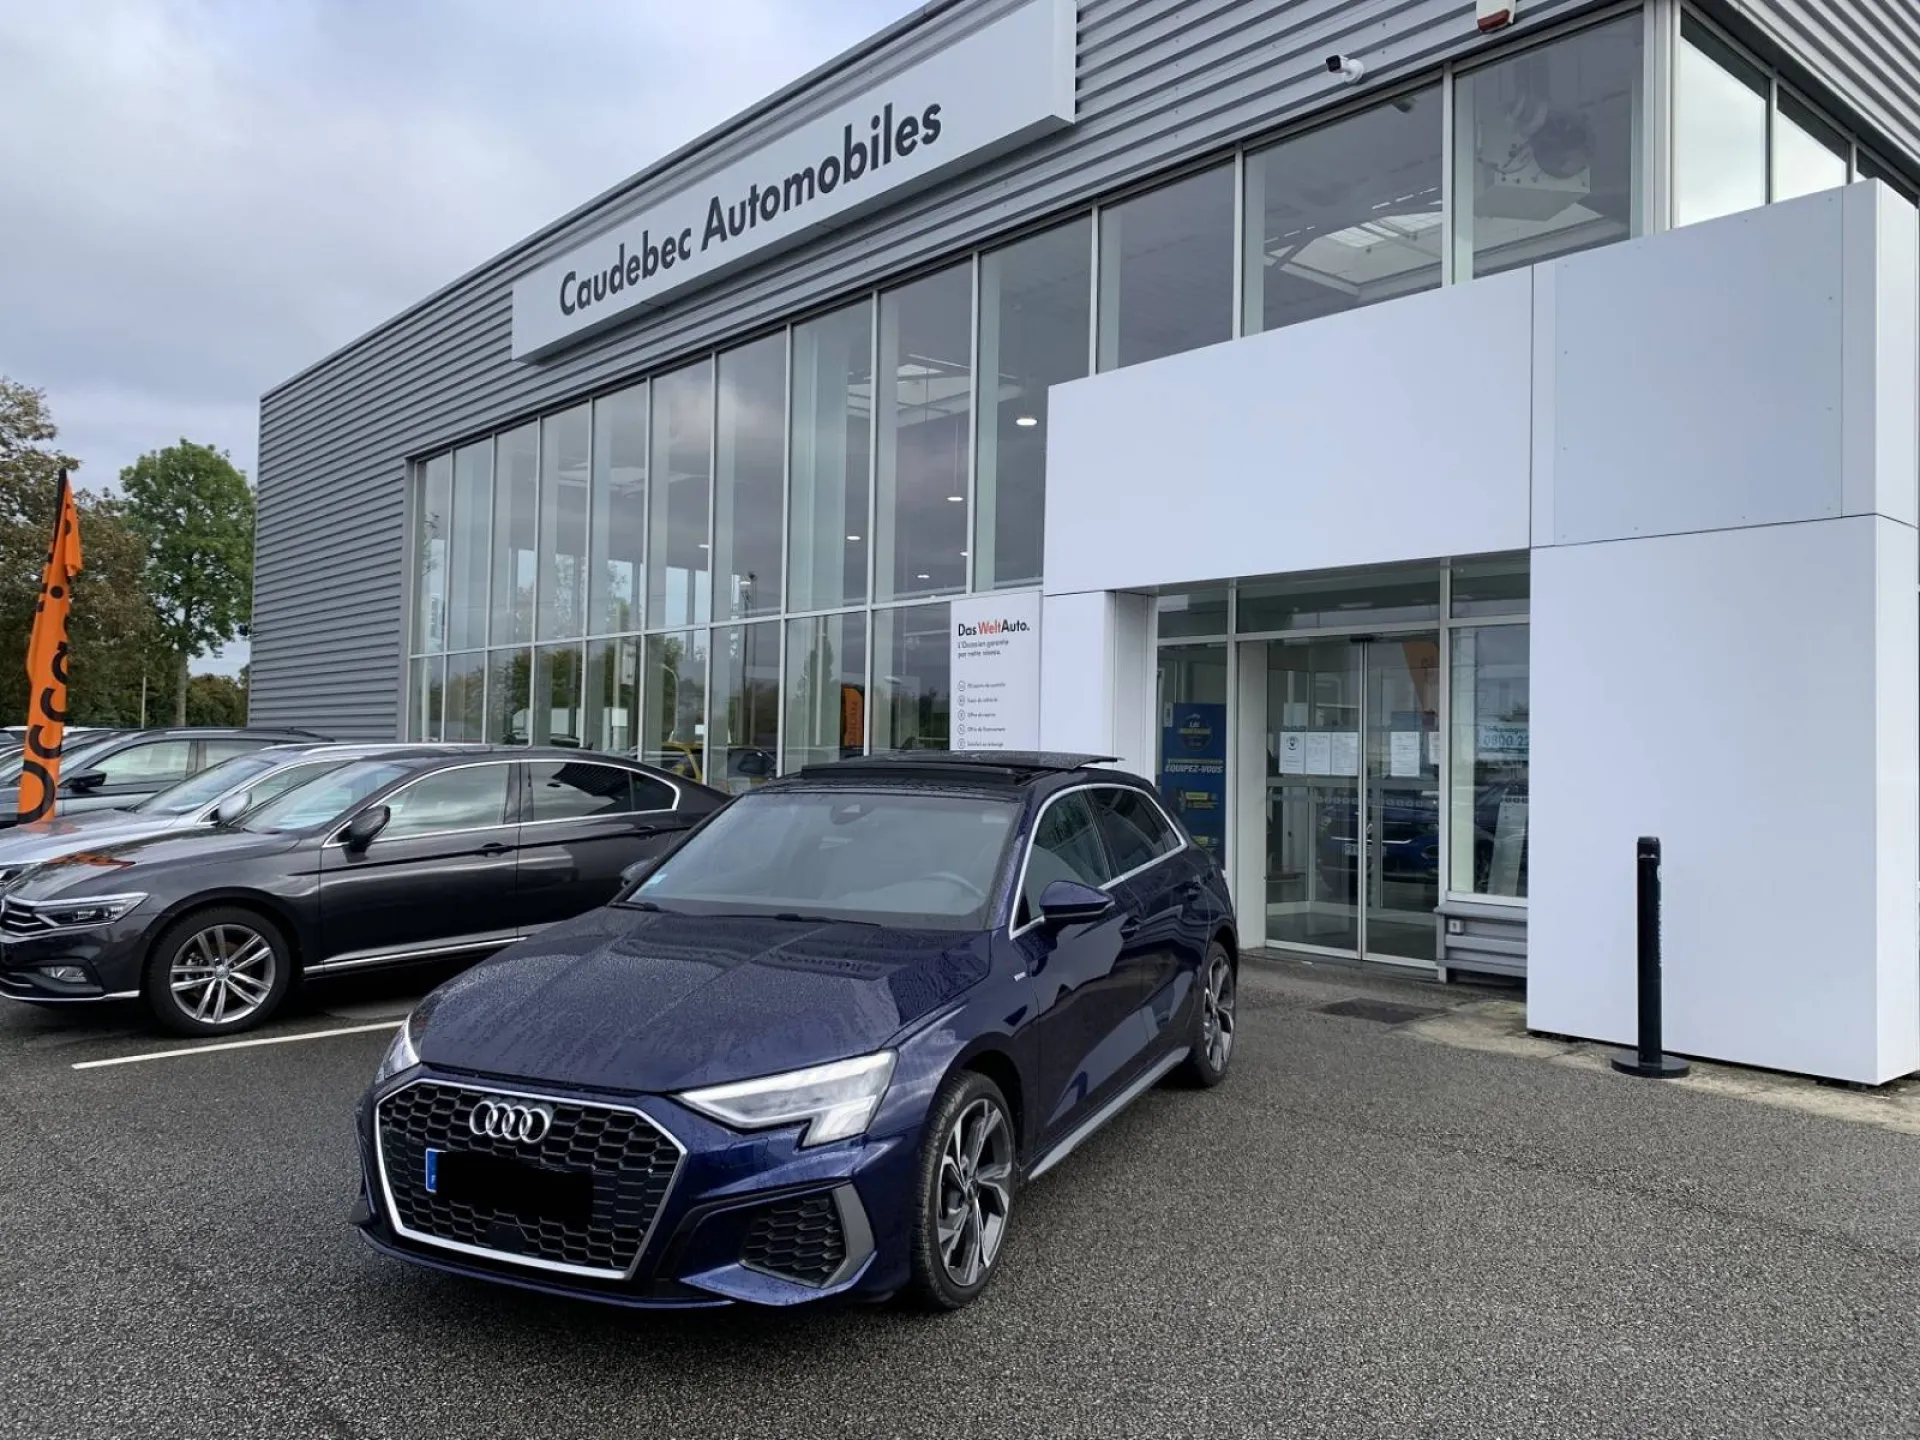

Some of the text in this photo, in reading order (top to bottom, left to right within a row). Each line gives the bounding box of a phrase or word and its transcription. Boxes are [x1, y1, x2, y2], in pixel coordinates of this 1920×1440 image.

[559, 102, 942, 316] Caudebec Automobiles
[958, 619, 1030, 637] Das WeltAuto.
